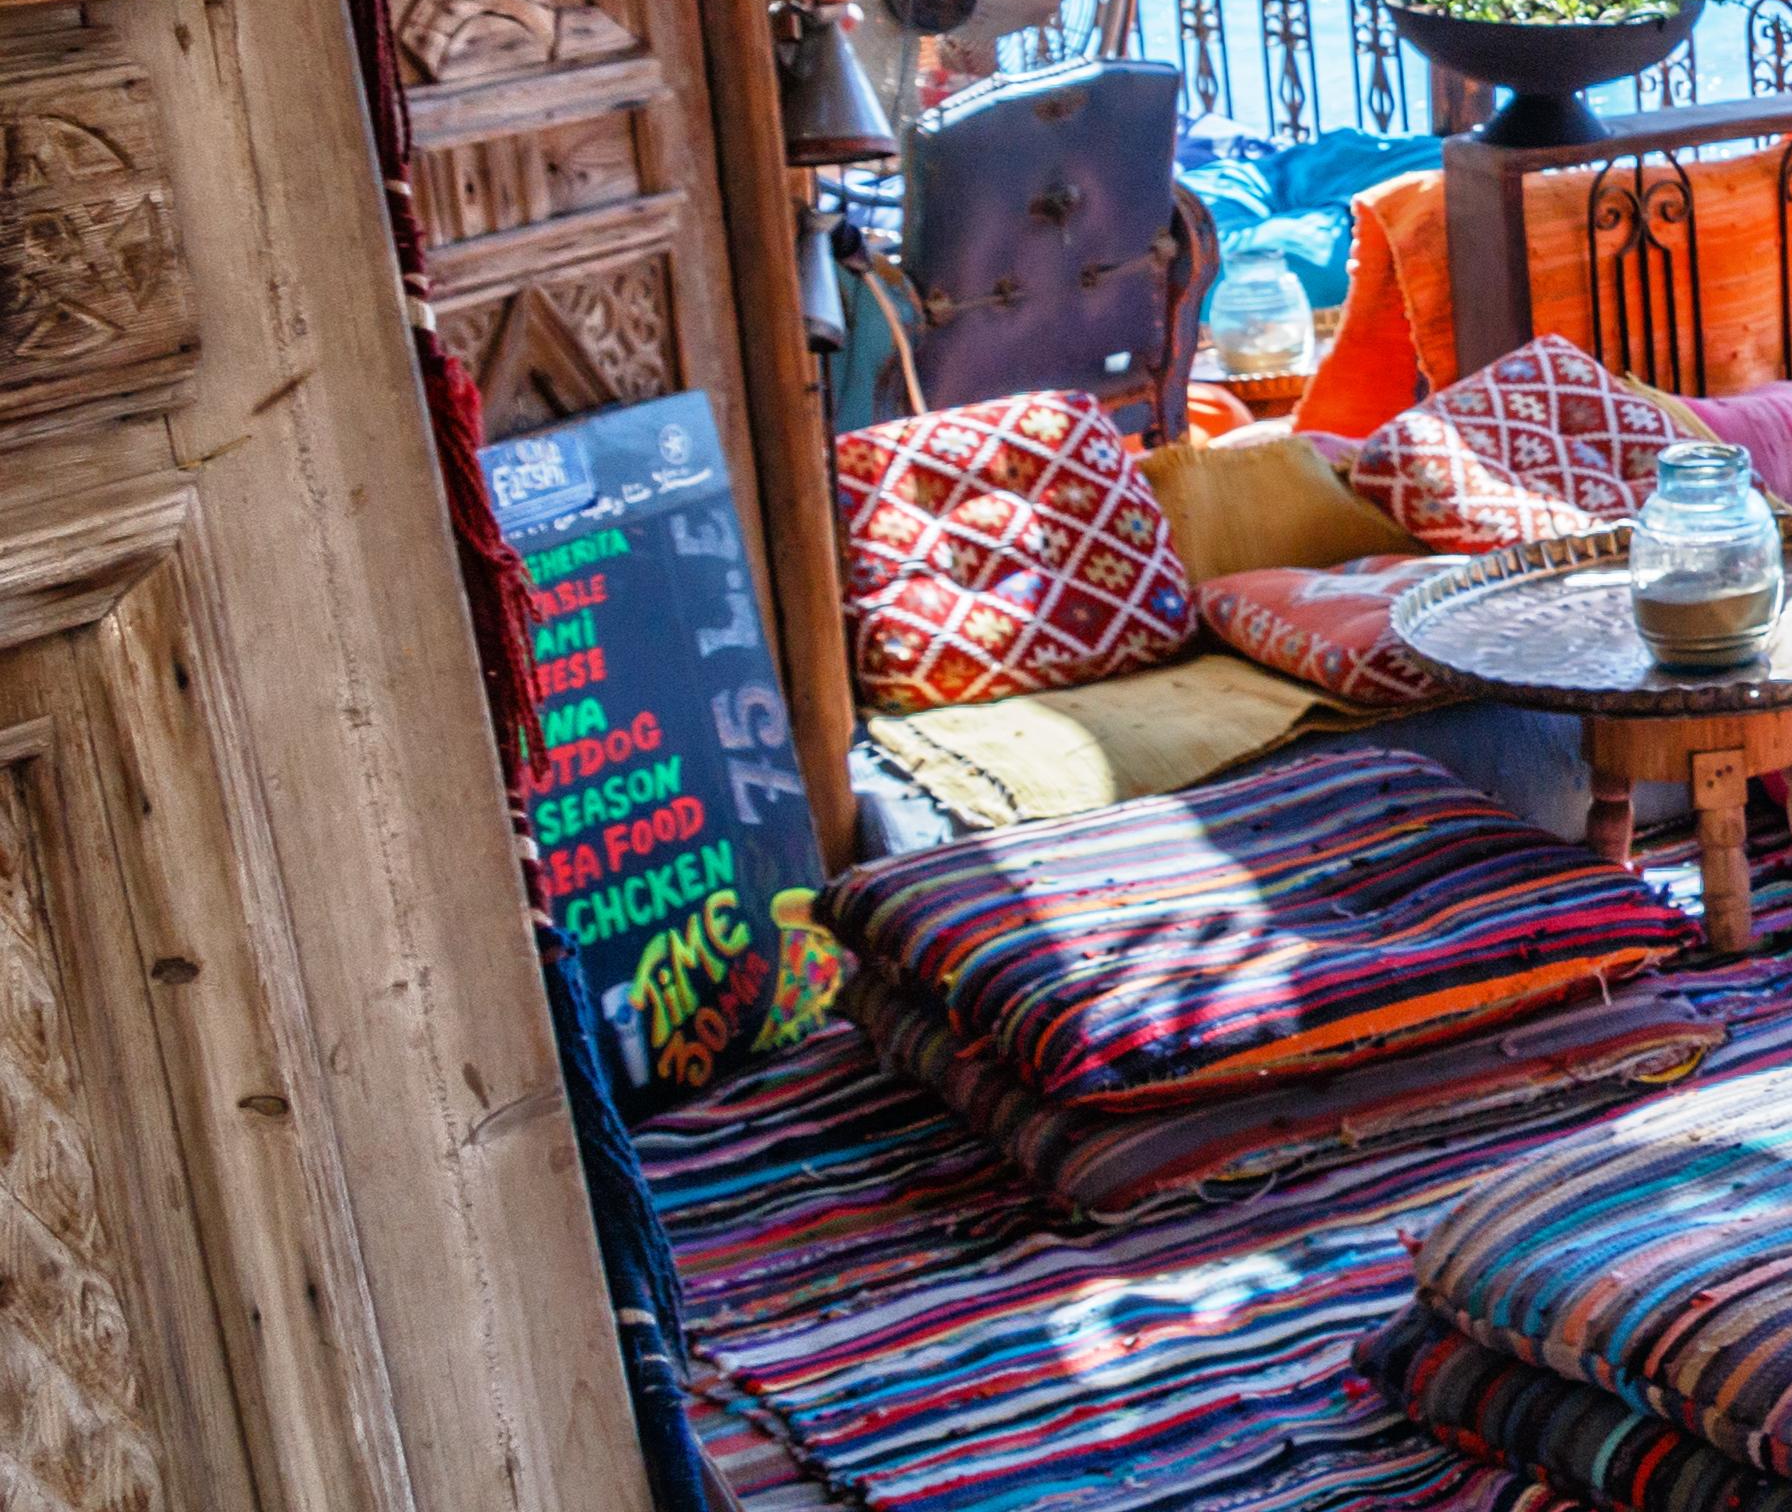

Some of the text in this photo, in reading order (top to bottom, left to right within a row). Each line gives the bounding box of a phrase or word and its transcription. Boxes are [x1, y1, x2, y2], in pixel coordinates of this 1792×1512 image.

[711, 680, 804, 826] 75
[535, 754, 682, 846] SEASON
[603, 796, 704, 873] FOOD
